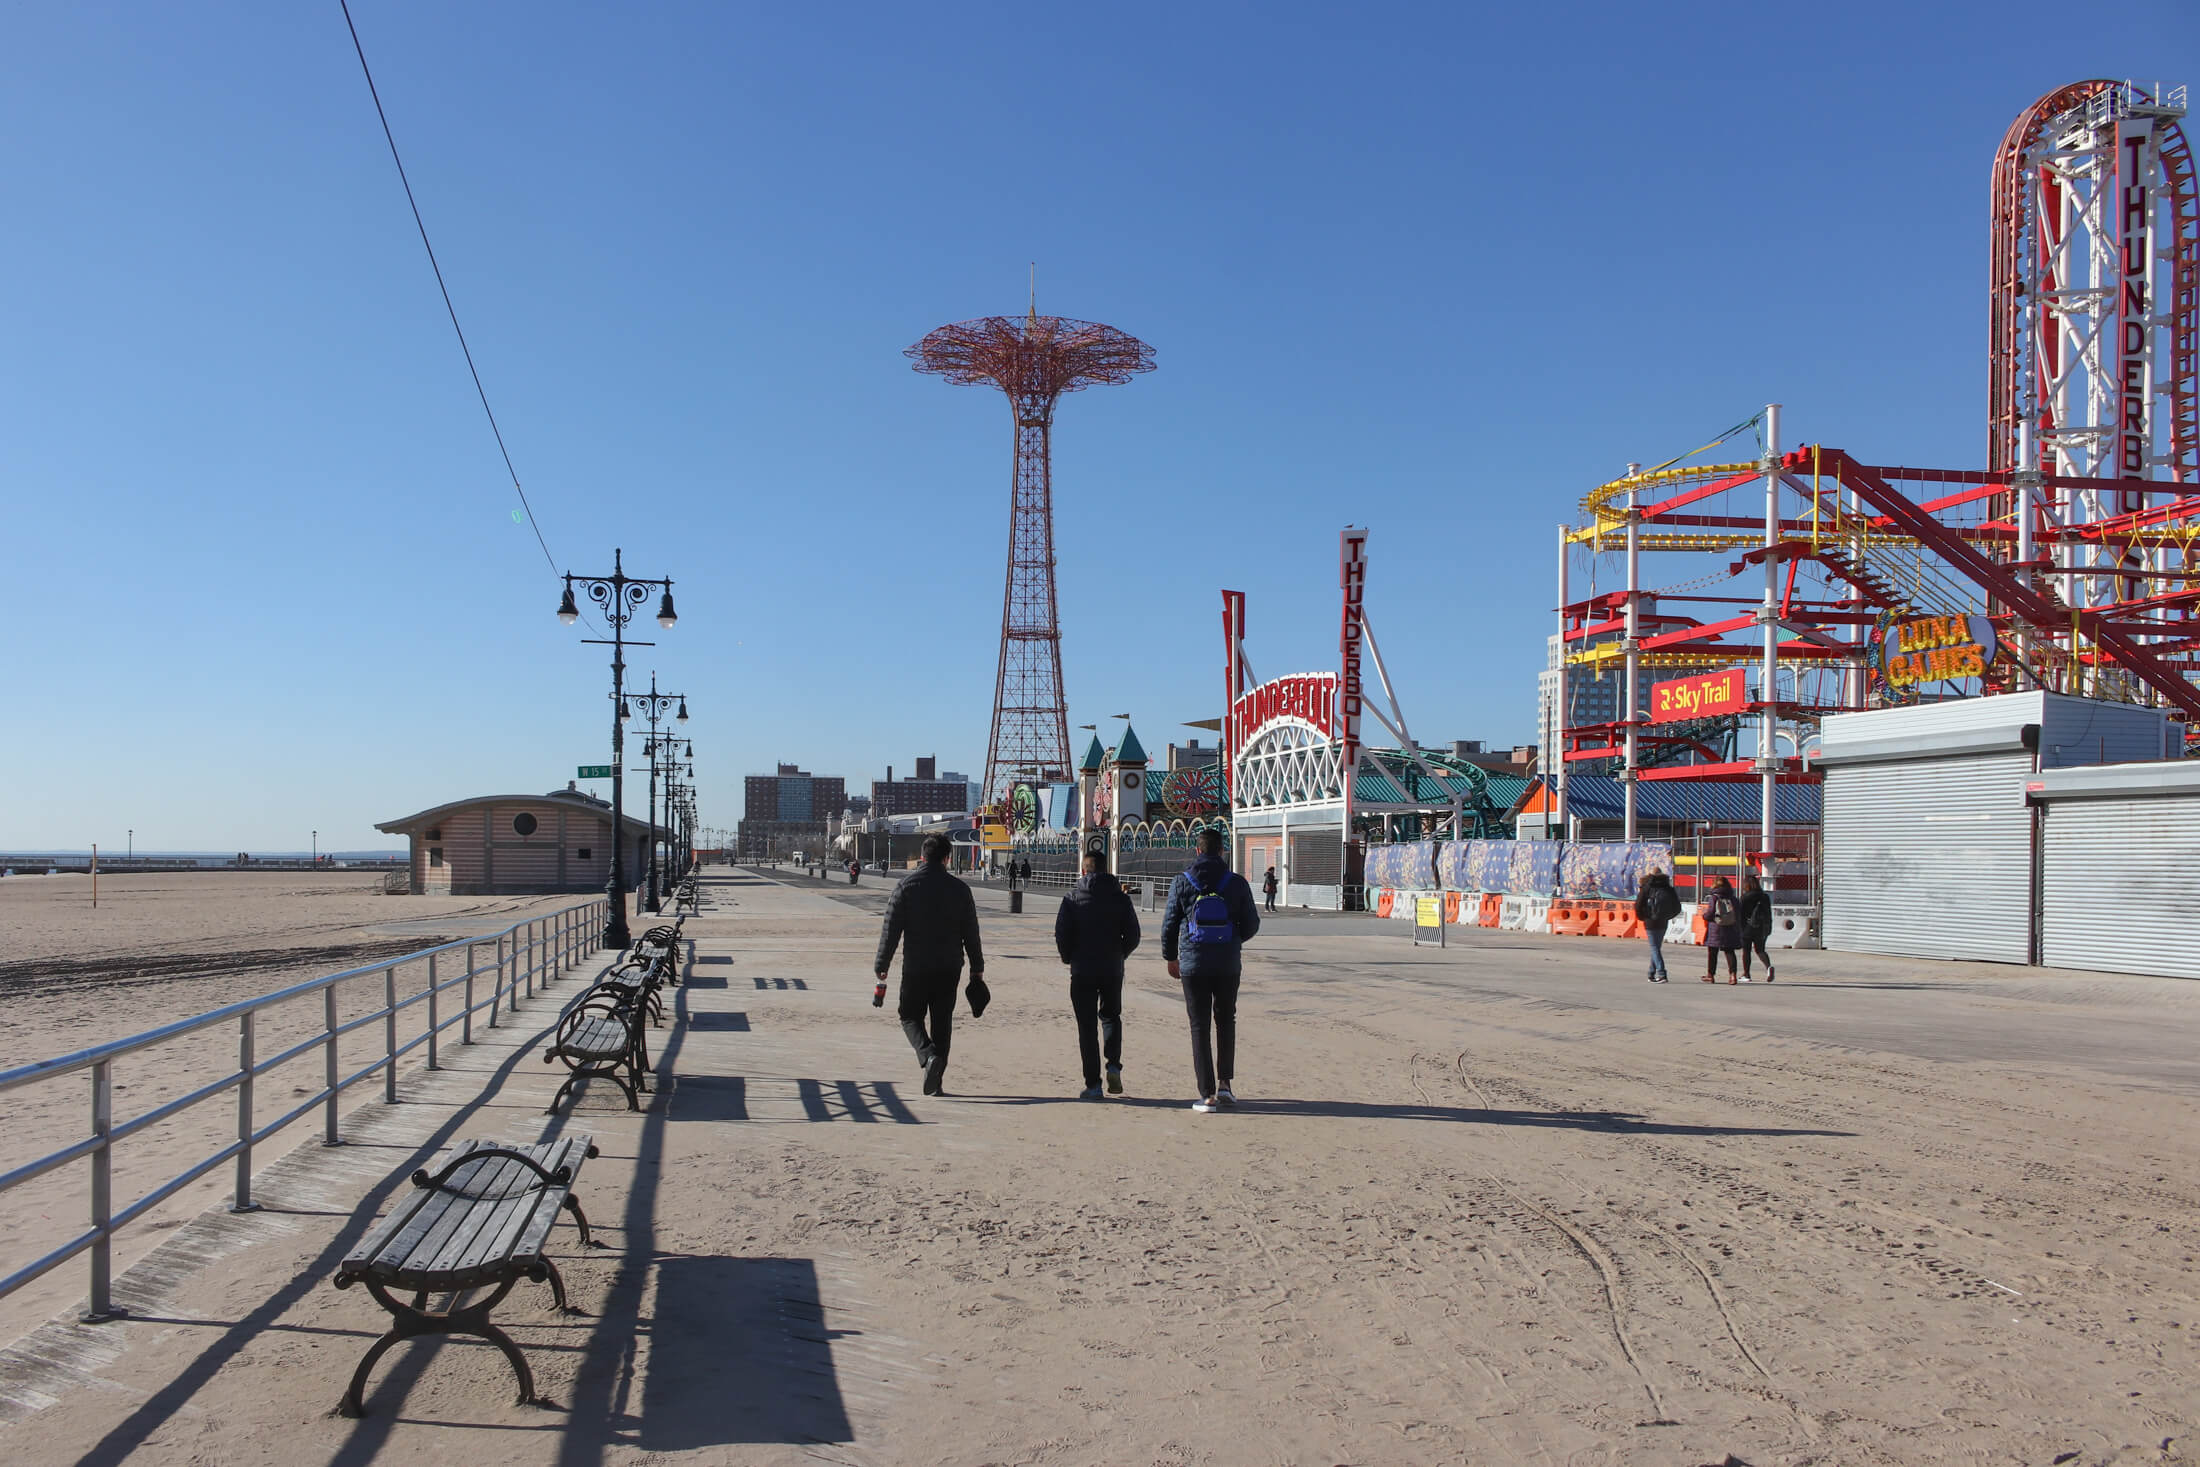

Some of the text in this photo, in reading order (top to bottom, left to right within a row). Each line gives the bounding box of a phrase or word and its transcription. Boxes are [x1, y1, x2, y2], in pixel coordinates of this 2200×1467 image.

[1344, 537, 1365, 766] THUNDERBOLT
[1897, 613, 1972, 653] LUNA
[1888, 643, 1986, 687] GAMES
[1674, 676, 1730, 713] Sky Trail
[1234, 676, 1335, 756] THUNDERBOLT
[582, 767, 589, 777] W
[591, 767, 600, 777] 15
